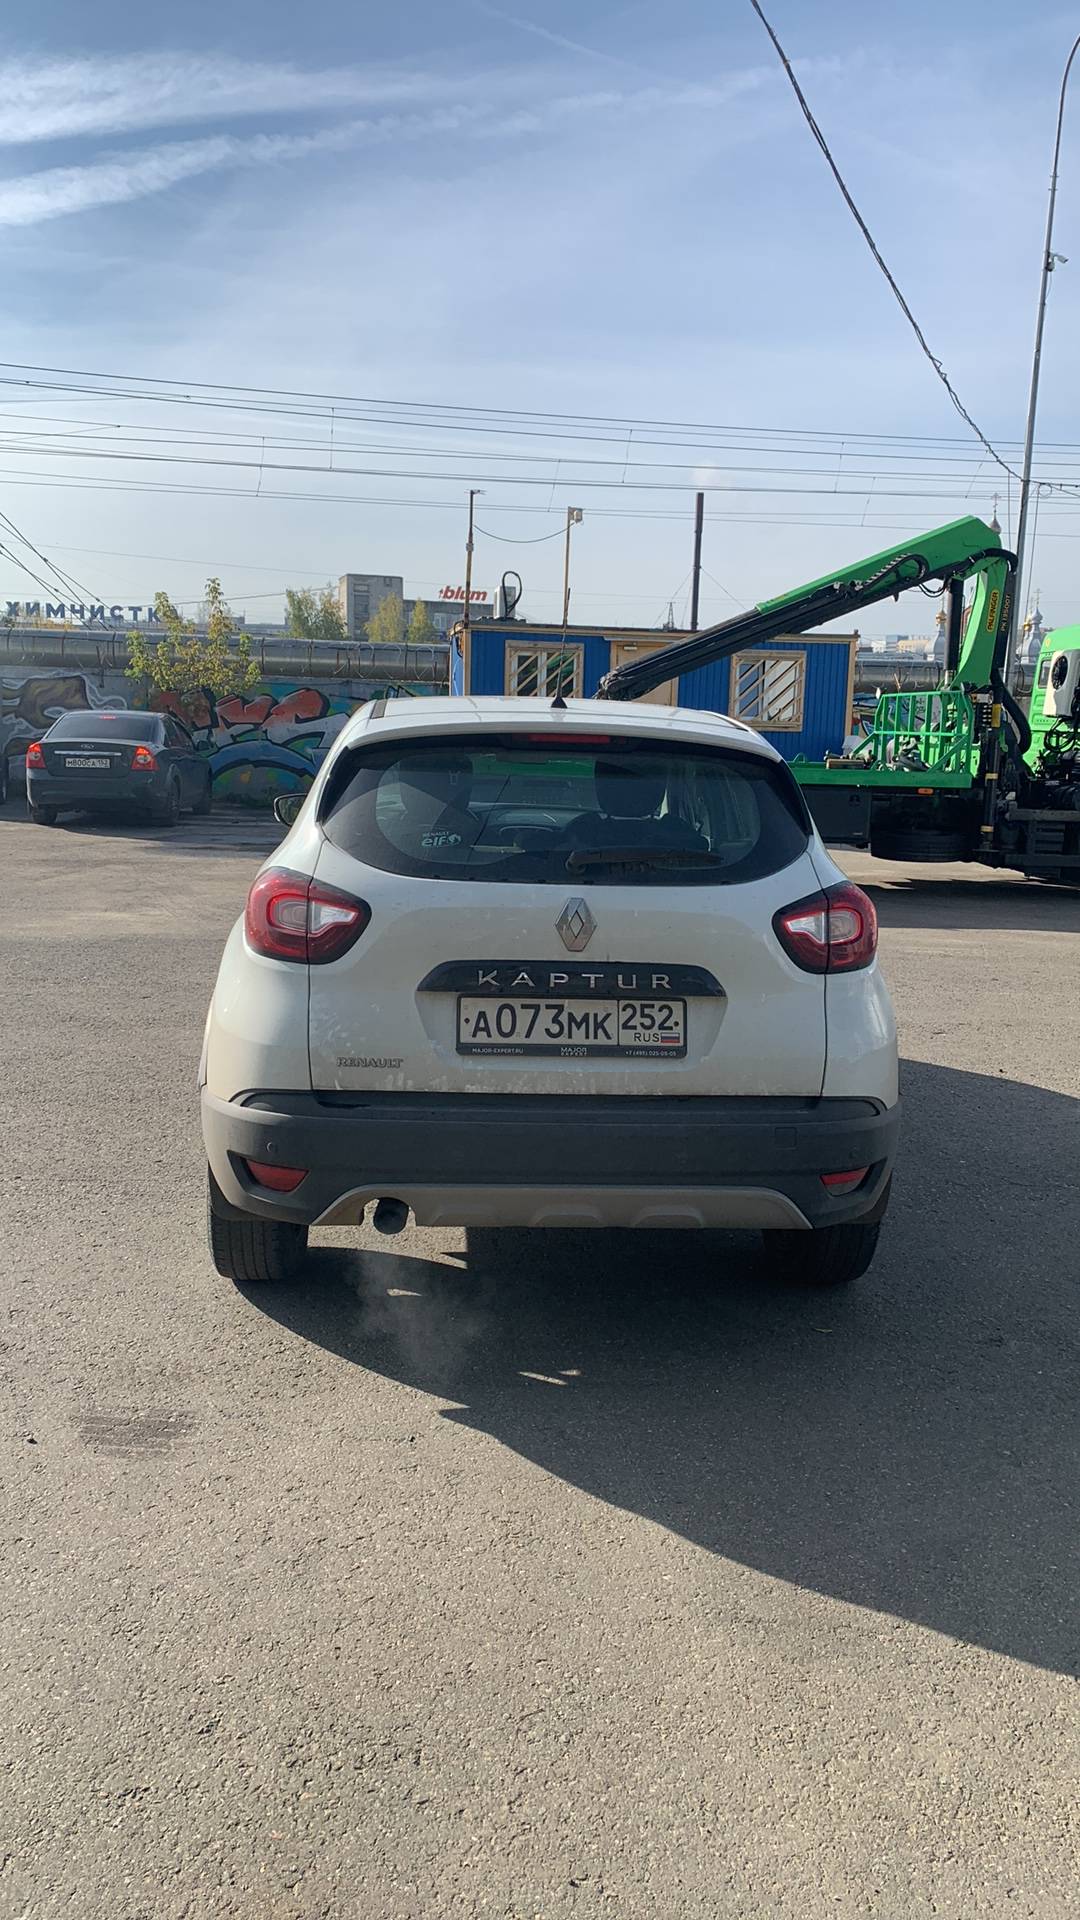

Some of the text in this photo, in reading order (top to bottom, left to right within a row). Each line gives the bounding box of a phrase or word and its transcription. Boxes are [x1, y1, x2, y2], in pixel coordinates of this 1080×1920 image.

[442, 586, 488, 601] blum
[477, 970, 671, 989] KAPTUR
[621, 1003, 674, 1031] 252
[633, 1033, 660, 1043] RUS
[337, 1057, 404, 1068] RENAULT
